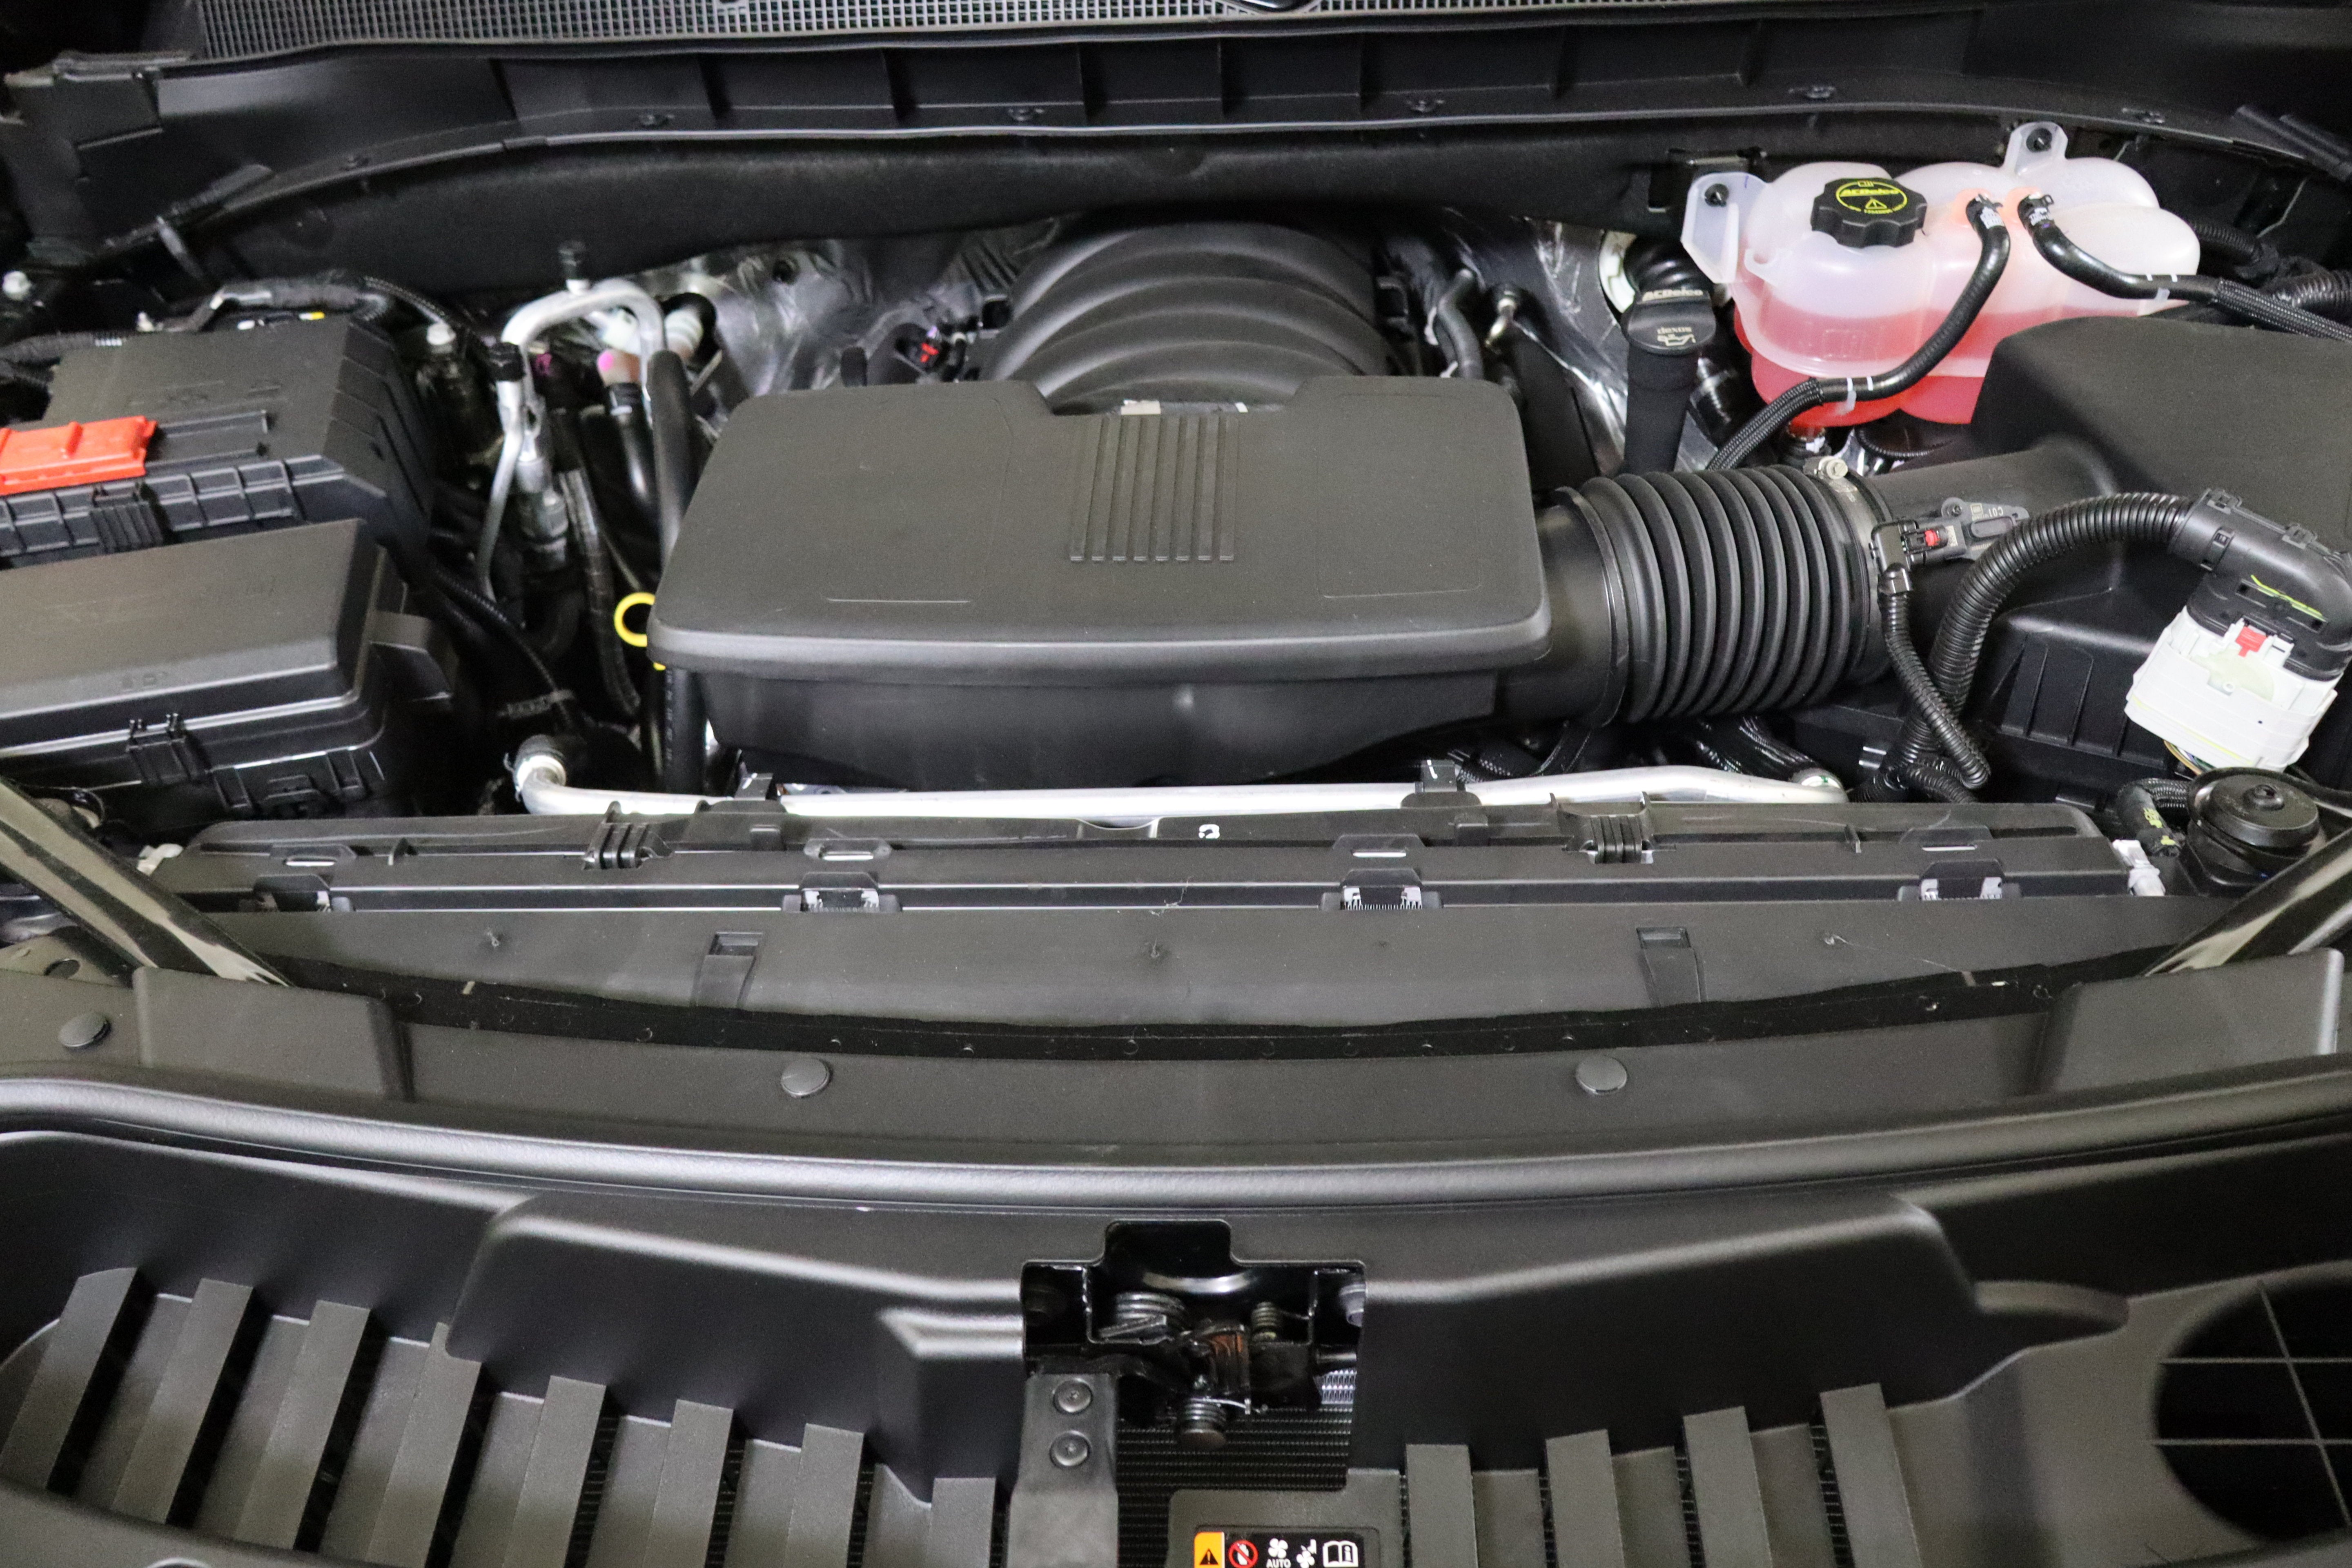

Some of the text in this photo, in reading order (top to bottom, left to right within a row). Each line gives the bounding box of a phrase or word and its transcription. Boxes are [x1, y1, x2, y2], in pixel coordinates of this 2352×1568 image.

[1840, 189, 1899, 197] ACDelco
[1642, 287, 1703, 301] ACDelco
[1266, 1559, 1292, 1568] AUTO
